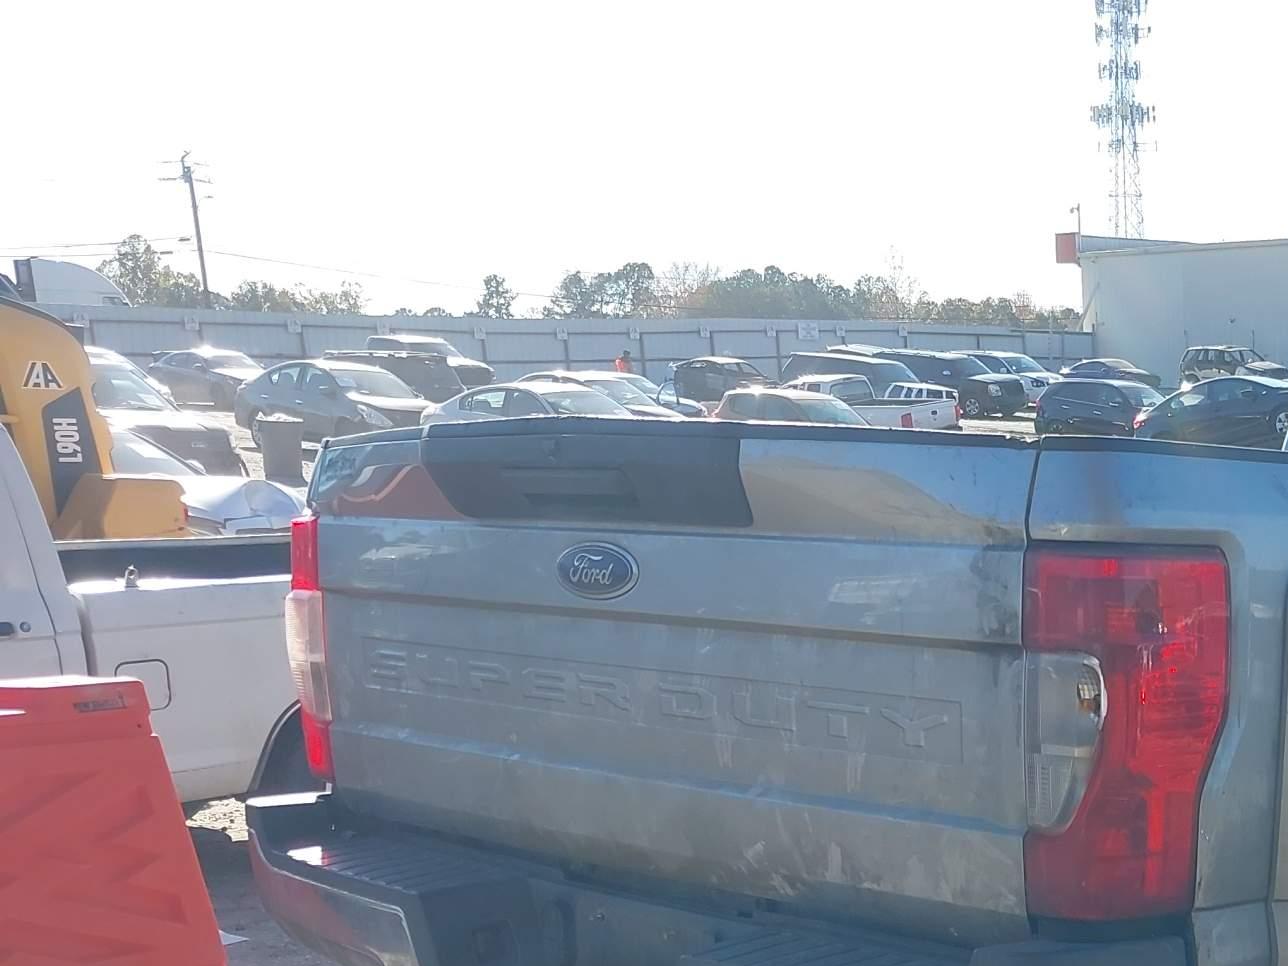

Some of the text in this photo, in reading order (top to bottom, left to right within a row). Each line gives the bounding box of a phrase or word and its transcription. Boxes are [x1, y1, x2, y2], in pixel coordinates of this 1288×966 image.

[52, 417, 83, 463] L90H
[569, 552, 614, 585] Ford
[364, 649, 949, 748] SUPER DUTY
